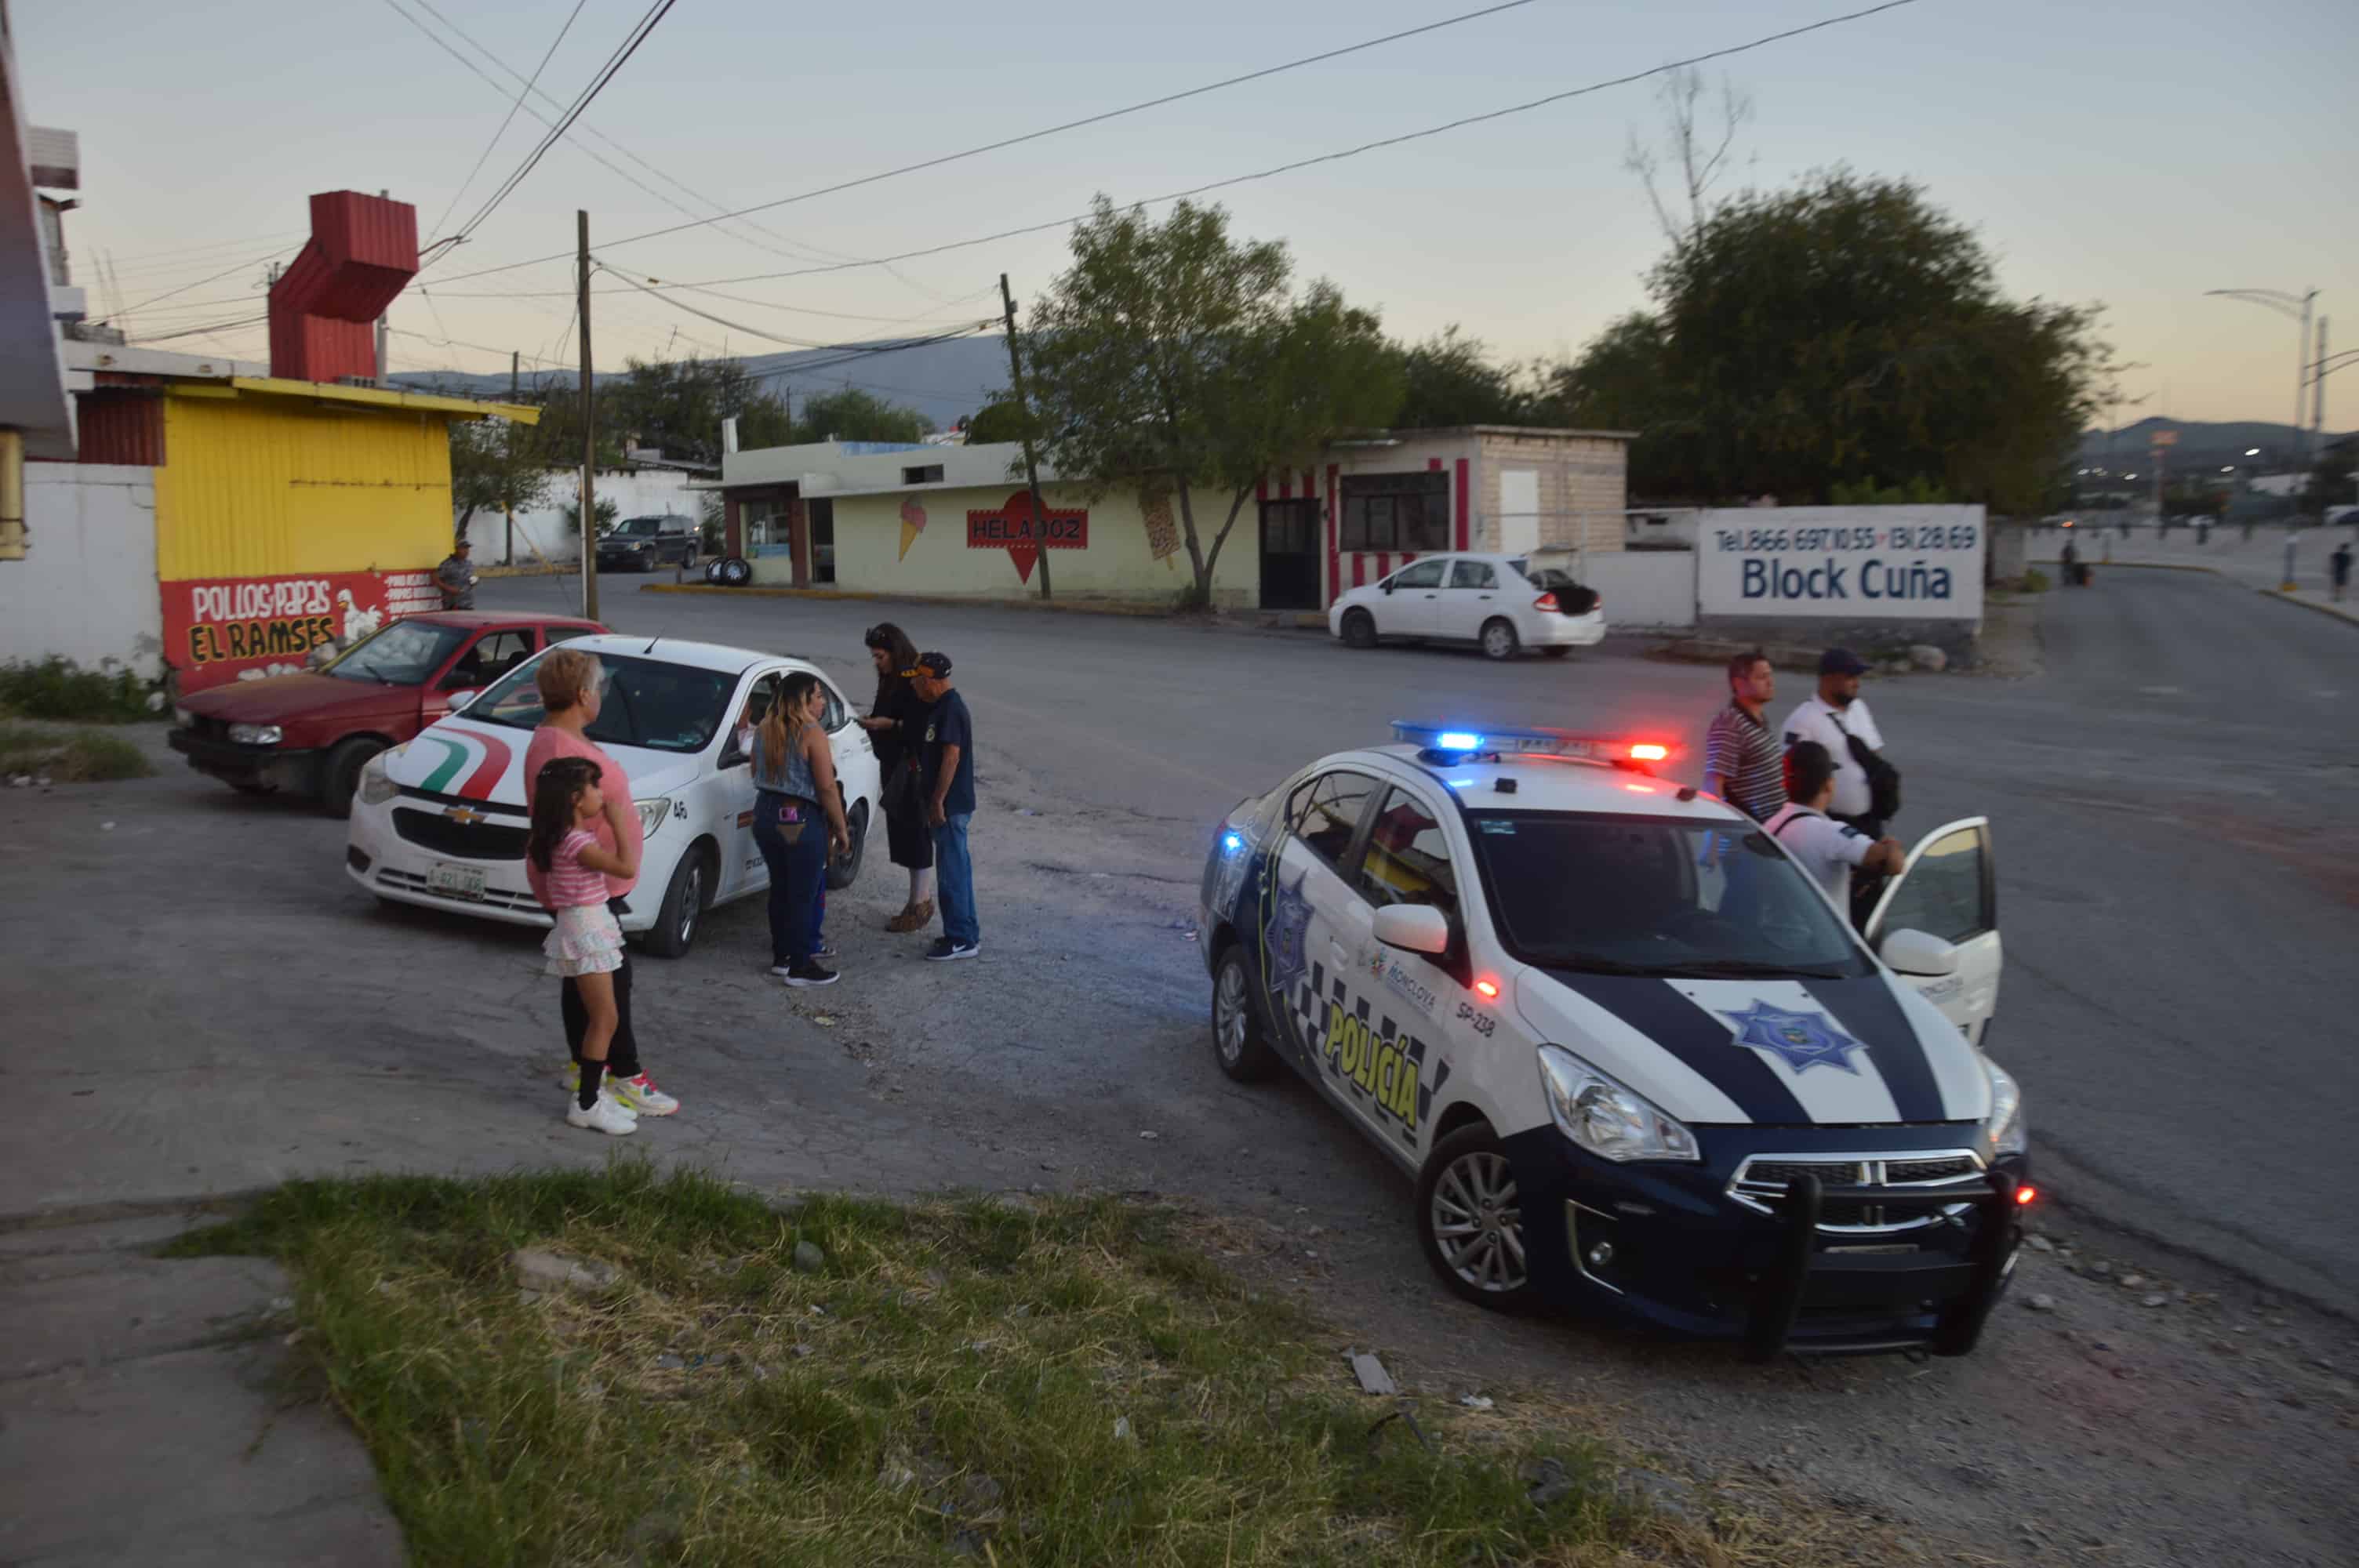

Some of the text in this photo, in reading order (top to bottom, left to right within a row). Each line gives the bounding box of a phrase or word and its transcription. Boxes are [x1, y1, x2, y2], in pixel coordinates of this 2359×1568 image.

[1741, 557, 1952, 599] Block Cuña
[192, 583, 272, 623] POLLOS
[189, 615, 336, 662] EL RAMSES
[1324, 999, 1419, 1131] POLICÍA
